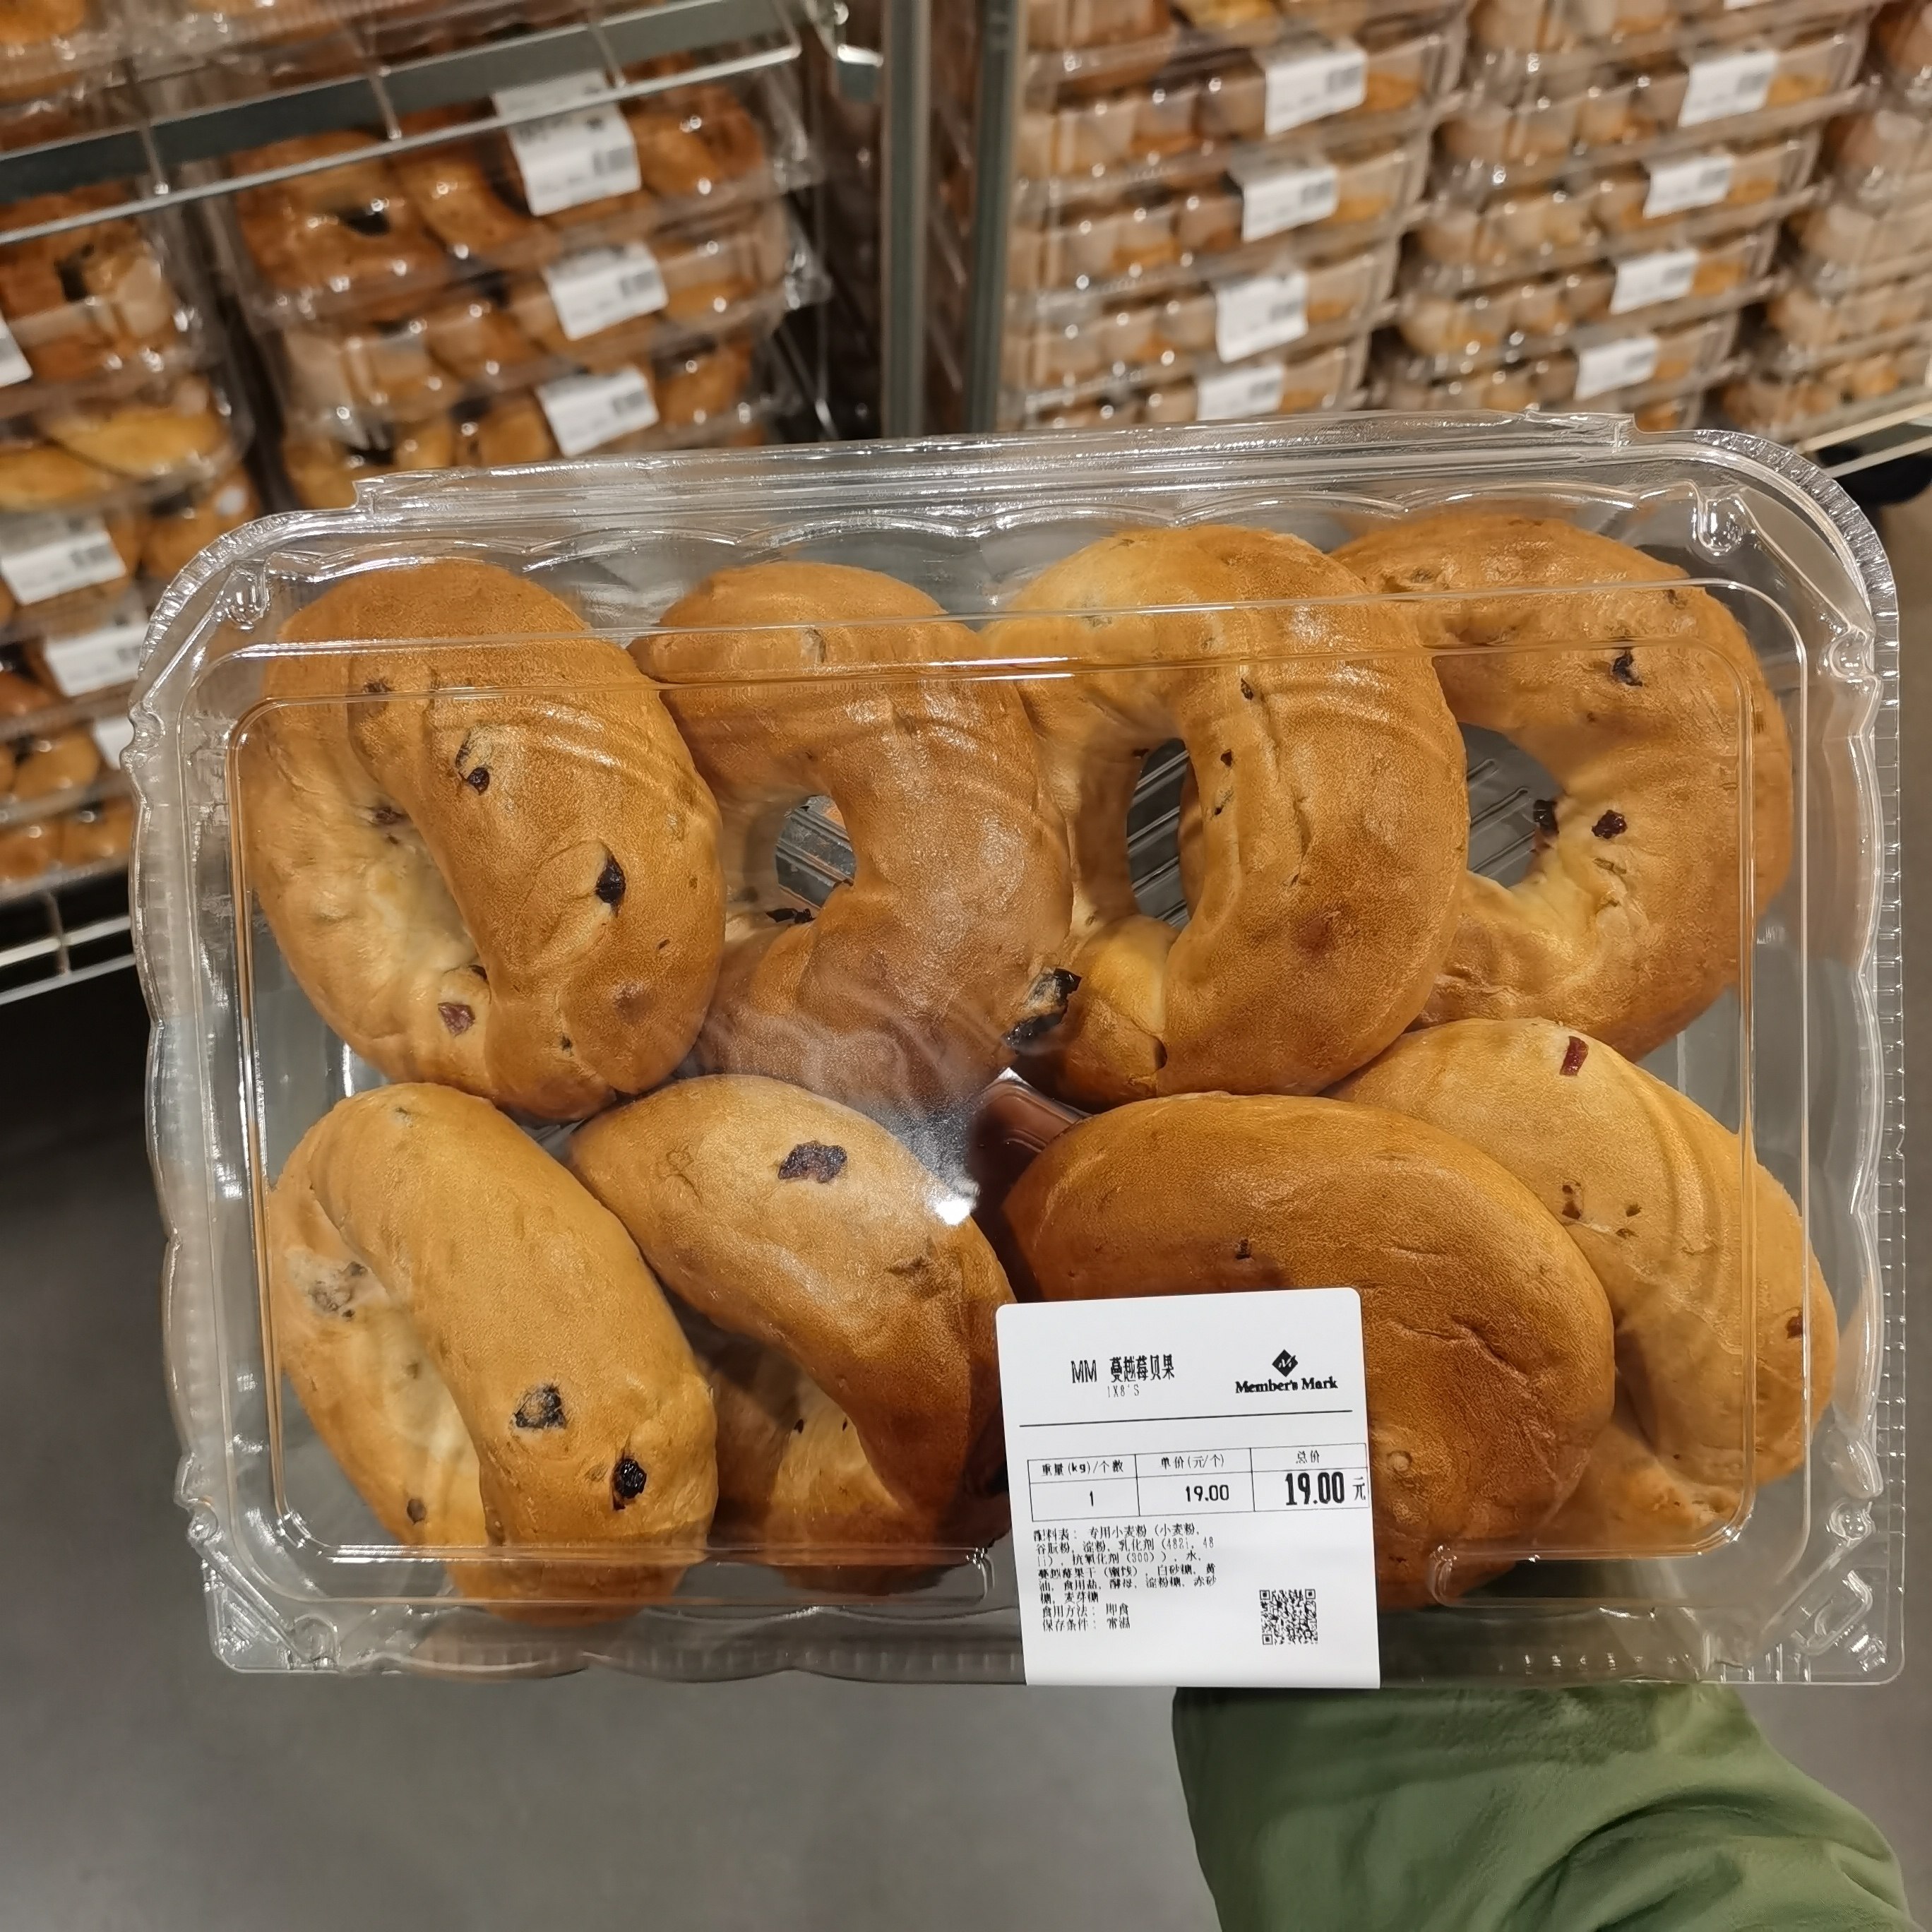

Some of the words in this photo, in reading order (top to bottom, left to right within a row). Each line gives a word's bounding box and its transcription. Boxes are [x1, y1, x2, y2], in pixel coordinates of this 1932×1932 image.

[1071, 1359, 1097, 1383] MM
[1109, 1354, 1175, 1383] 蔓越莓贝果
[1235, 1378, 1299, 1394] Member's
[1301, 1376, 1338, 1390] Mark
[1295, 1450, 1320, 1465] 总价
[1186, 1484, 1229, 1503] 19.00
[1285, 1471, 1345, 1506] 19.00
[1352, 1476, 1366, 1501] 元
[1090, 1490, 1094, 1507] 1
